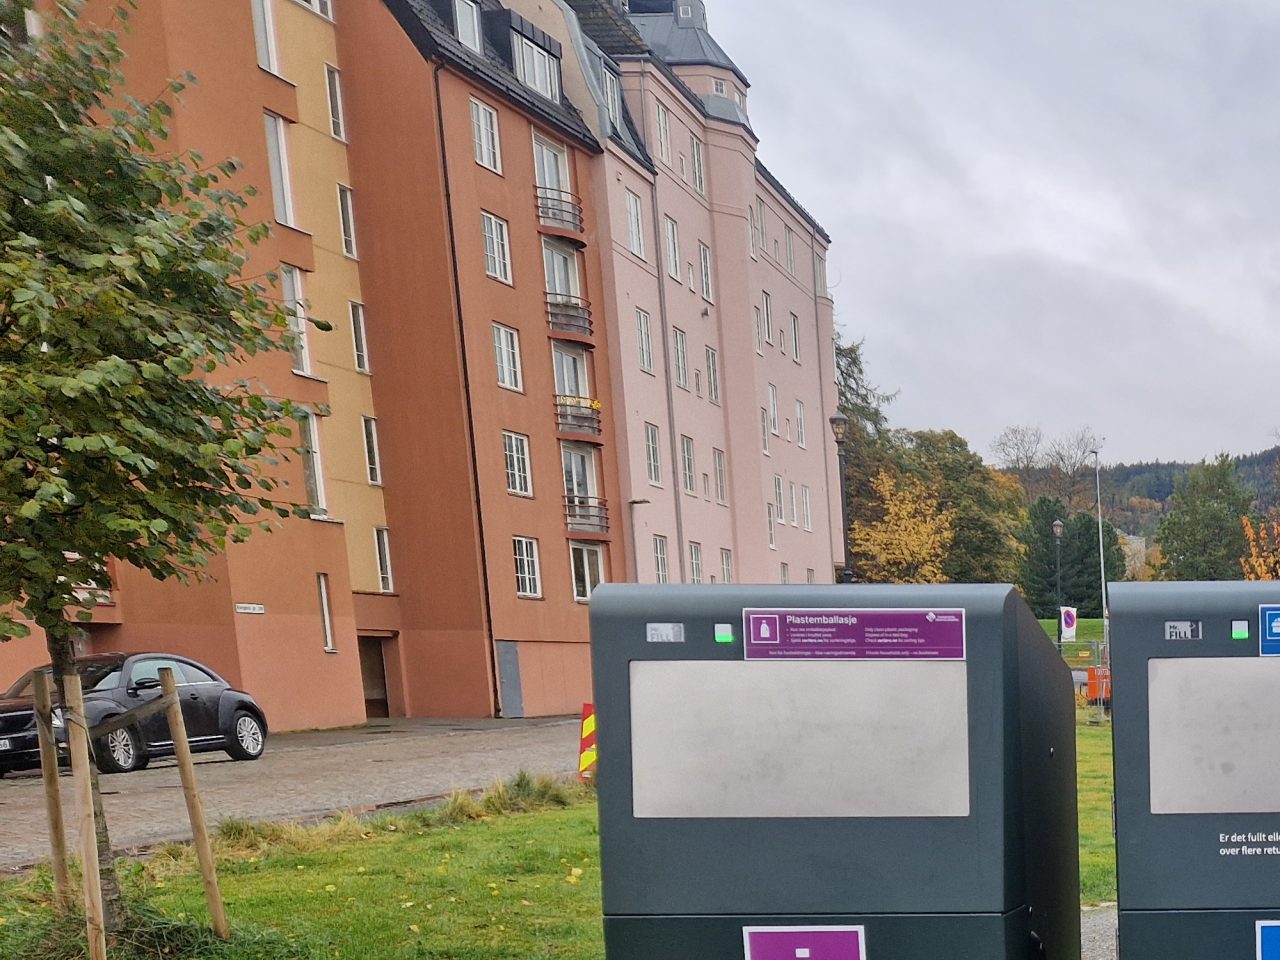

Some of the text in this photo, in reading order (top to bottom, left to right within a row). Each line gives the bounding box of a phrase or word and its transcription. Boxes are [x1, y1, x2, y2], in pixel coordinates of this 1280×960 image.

[786, 615, 858, 626] Plastemballasje
[1169, 630, 1189, 639] FILL
[1219, 833, 1229, 842] Er
[1230, 832, 1246, 842] det
[1247, 832, 1266, 842] fullt
[1219, 846, 1240, 855] over
[1241, 845, 1262, 855] flere
